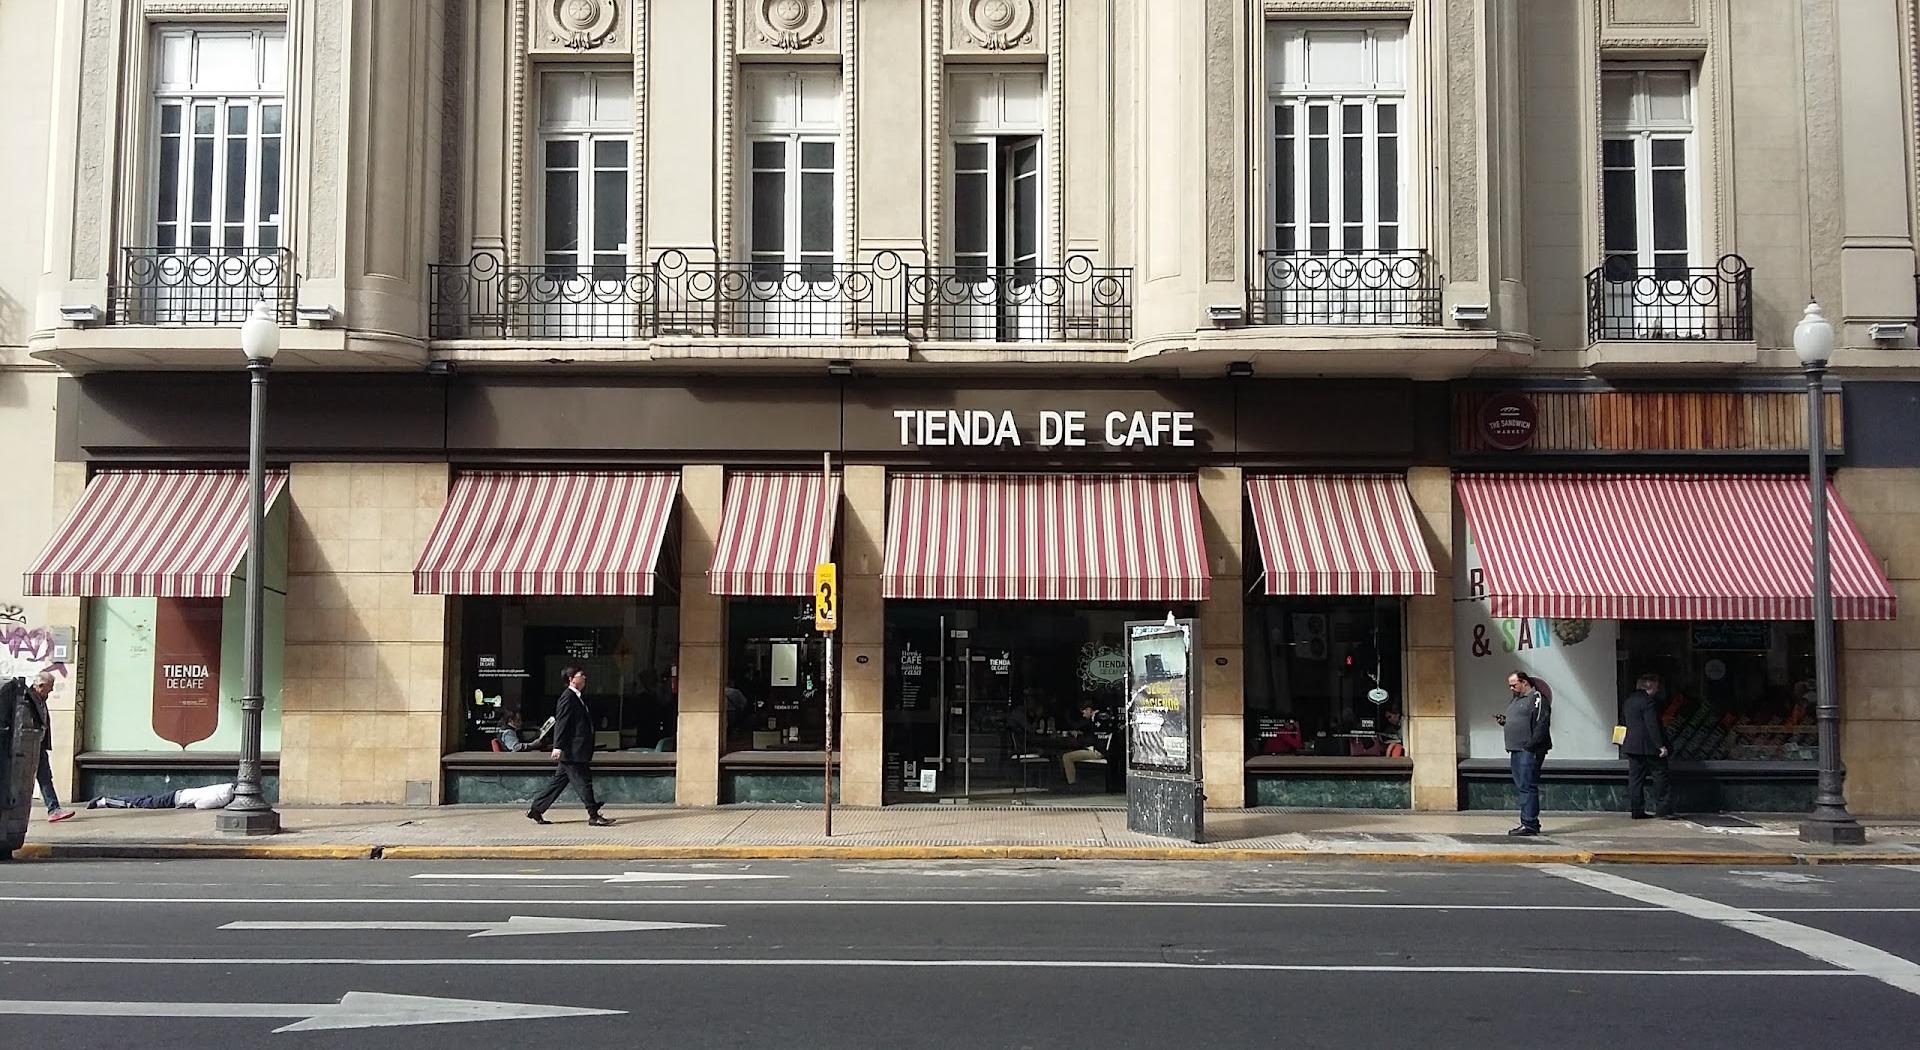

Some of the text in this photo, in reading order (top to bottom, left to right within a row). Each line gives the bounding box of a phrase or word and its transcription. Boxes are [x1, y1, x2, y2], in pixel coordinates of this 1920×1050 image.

[893, 410, 1195, 447] TIENDA DE CAFE
[1490, 420, 1531, 429] THE SANDWICH
[820, 582, 832, 620] 3
[1472, 624, 1492, 657] &
[1098, 660, 1125, 668] TIENDA
[163, 665, 209, 678] TIENDA
[166, 679, 205, 689] DE CAFE
